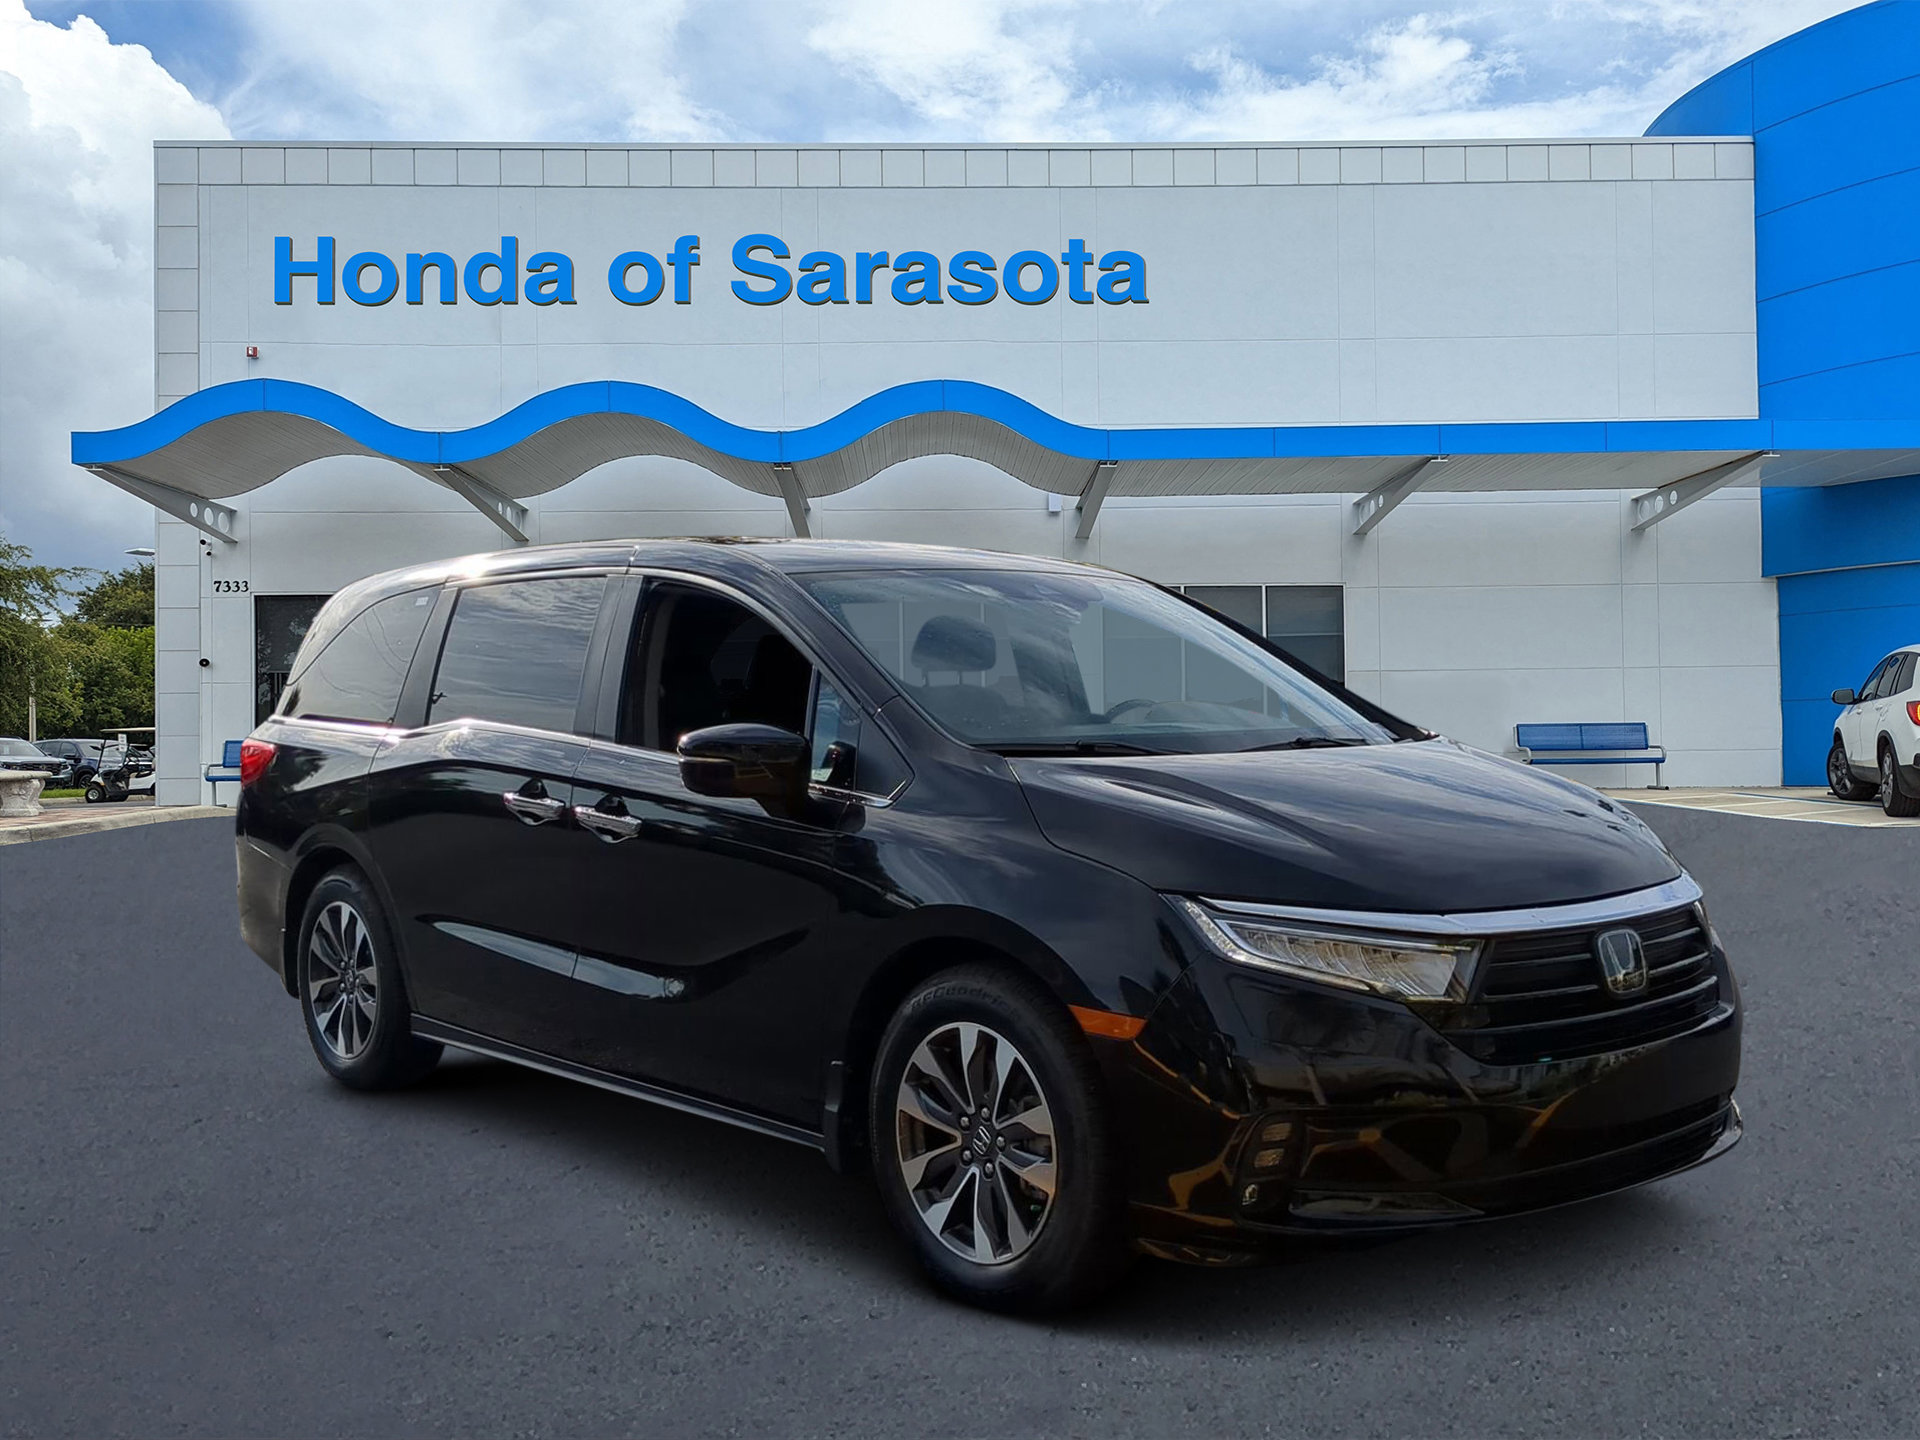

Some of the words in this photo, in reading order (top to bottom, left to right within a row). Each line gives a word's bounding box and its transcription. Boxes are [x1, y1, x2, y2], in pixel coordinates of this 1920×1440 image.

[273, 234, 577, 306] Honda
[607, 233, 702, 306] of
[729, 233, 1150, 306] Sarasota
[213, 580, 249, 593] 7333
